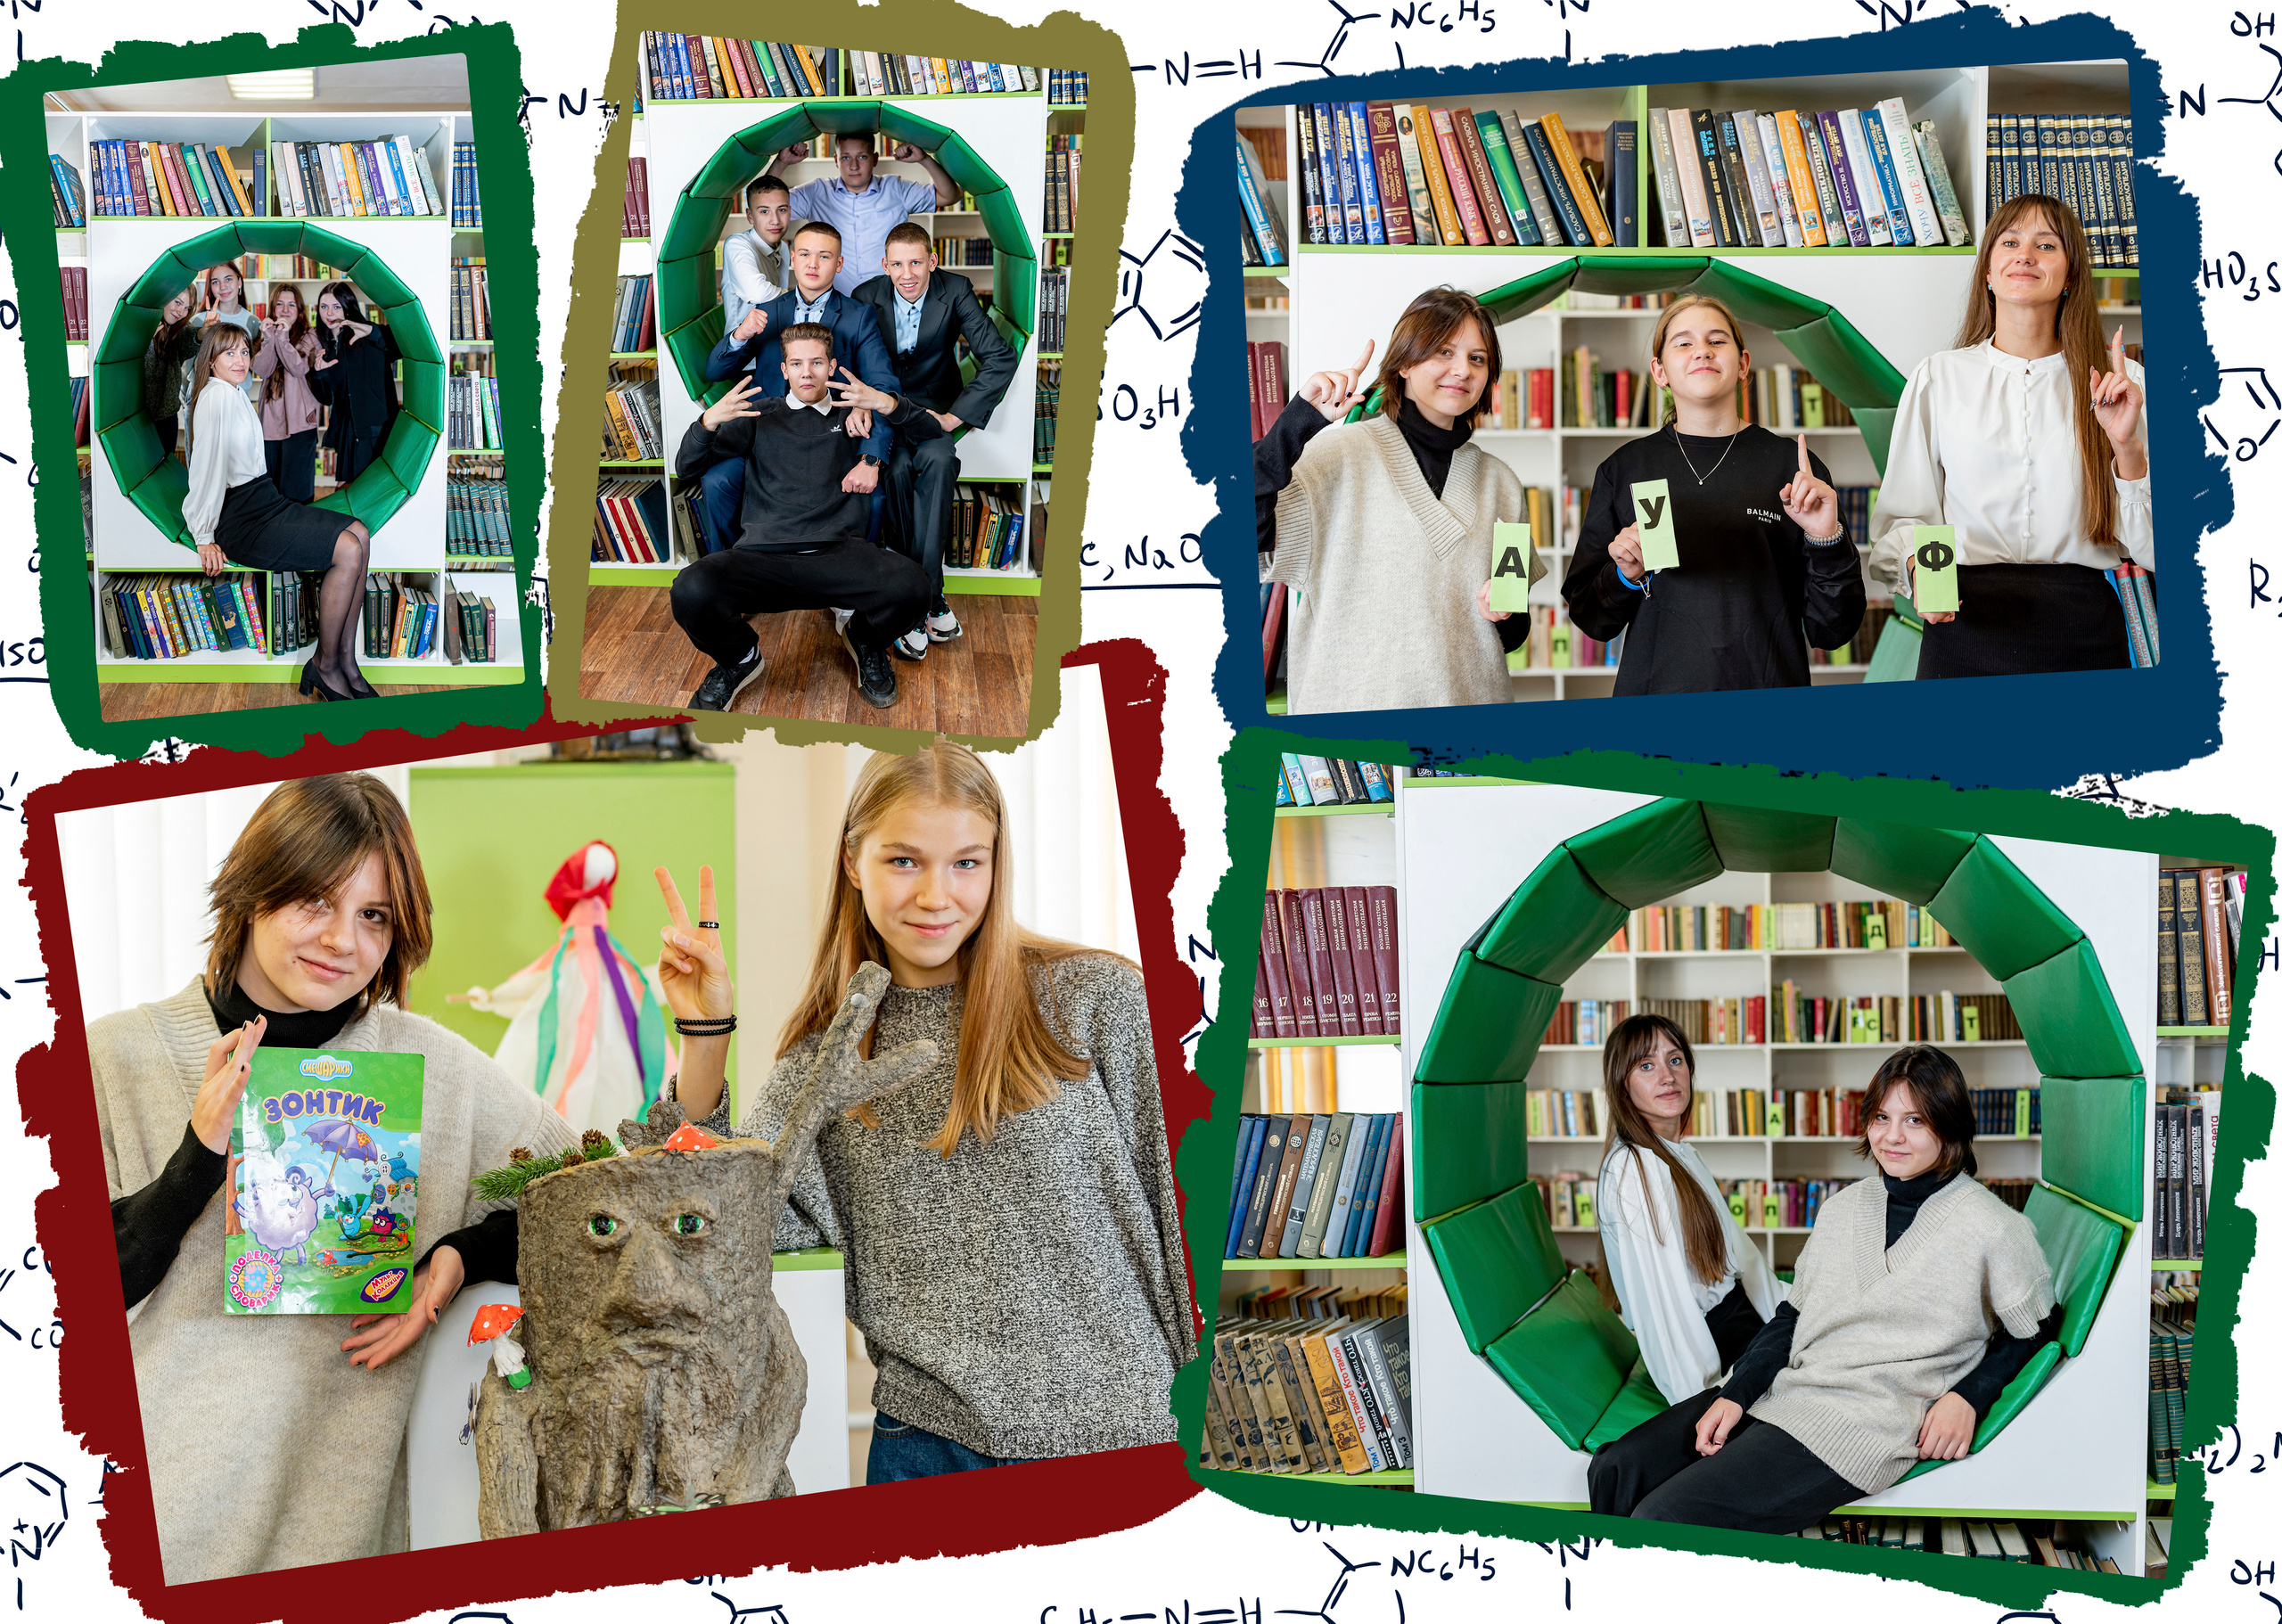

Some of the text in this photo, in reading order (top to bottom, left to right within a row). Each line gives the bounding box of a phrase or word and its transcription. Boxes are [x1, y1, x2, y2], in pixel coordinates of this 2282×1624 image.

[1418, 111, 1444, 196] СЛОВАРЬ РУССКОГО ЯЗЫКА
[1461, 116, 1501, 224] СЛОВАРЬ ИНОСТРАННЫХ СЛОВ
[1379, 156, 1390, 196] СОВРЕМЕННЫЙ
[1389, 174, 1398, 202] ТОЛКОВЫЙ
[1394, 170, 1402, 197] РУССКОГО
[1533, 128, 1580, 233] СЛОВАРЬ ИНОСТРАННЫХ СЛОВ
[1669, 172, 1678, 204] ЛИТЕРАТУРА
[1753, 175, 1762, 200] РУССКАЯ
[1809, 132, 1834, 215] ЭНЦИКЛОПЕДИЯ
[1840, 174, 1852, 206] ИСКУССТВО
[1884, 164, 1899, 206] ИНФОРМАТИКА
[1899, 134, 1934, 241] ХОЧУ ВСЁ ЗНАТЬ!
[2062, 162, 2070, 195] РОССИЙСКАЯ
[2078, 162, 2086, 195] РОССИЙСКАЯ
[2102, 161, 2115, 219] ЭНЦИКЛОПЕДИЯ
[2121, 161, 2134, 219] ЭНЦИКЛОПЕДИЯ
[1454, 168, 1477, 220] РУССКИЙ ЯЗЫК
[2084, 162, 2097, 220] ЭНЦИКЛОПЕДИЯ
[2090, 237, 2096, 245] 6
[2110, 236, 2115, 244] 7
[2129, 236, 2134, 244] 8
[1746, 507, 1781, 521] BALMAIN
[1758, 515, 1772, 523] PARIS
[1493, 546, 1527, 578] А
[1917, 541, 1954, 571] Ф
[2121, 582, 2132, 624] ПРОГРАММА
[1316, 900, 1326, 951] ЭНЦИКЛОПЕДИЯ
[1336, 900, 1347, 950] ЭНЦИКЛОПЕДИЯ
[1359, 900, 1368, 950] ЭНЦИКЛОПЕДИЯ
[1382, 900, 1391, 949] ЭНЦИКЛОПЕДИЯ
[1258, 997, 1269, 1009] 16
[1278, 997, 1287, 1007] 17
[1302, 996, 1313, 1006] 18
[1322, 994, 1333, 1005] 19
[1342, 994, 1354, 1005] 20
[1365, 993, 1375, 1004] 21
[1385, 993, 1397, 1003] 22
[302, 1060, 351, 1077] СМЕШАРИКИ
[265, 1089, 386, 1127] ЗОНТИК
[1301, 1128, 1317, 1180] МАТЕМАТИЧЕСКАЯ
[1305, 1129, 1323, 1182] ЭНЦИКЛОПЕДИЯ
[231, 1249, 281, 1274] ПОДЕЛКА
[231, 1283, 282, 1308] СЛОВАРИК
[1333, 1346, 1366, 1433] Что такое Кто такой
[1345, 1339, 1357, 1359] ЧТО
[1361, 1388, 1374, 1407] КТО
[1369, 1409, 1381, 1431] такой
[1365, 1339, 1398, 1424] Что такое Кто такой
